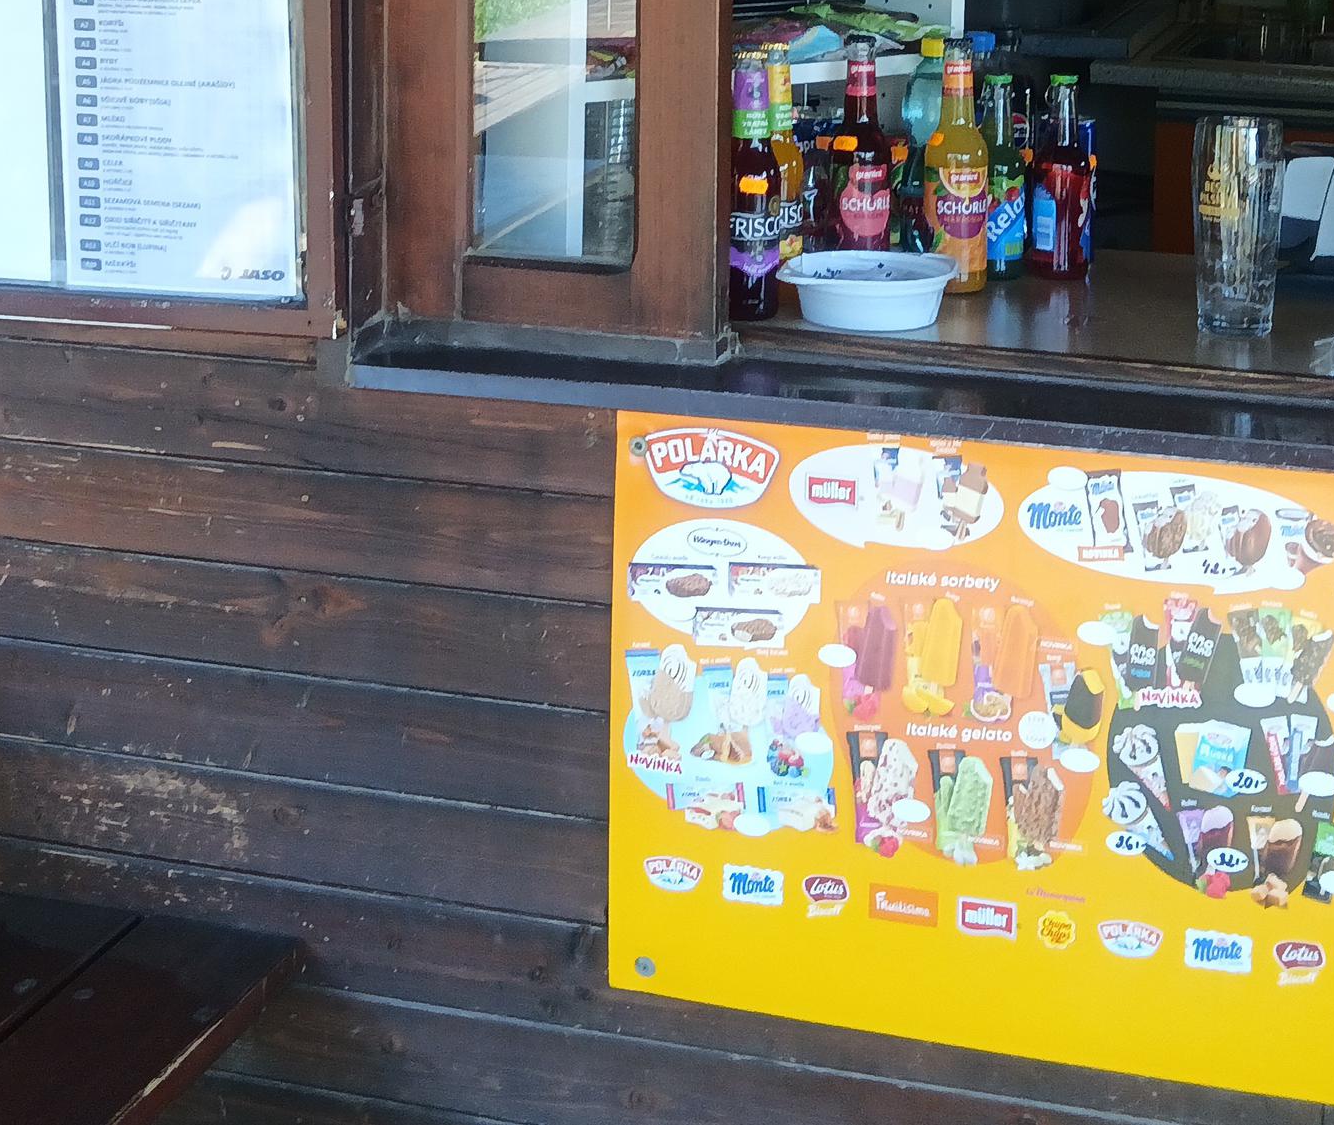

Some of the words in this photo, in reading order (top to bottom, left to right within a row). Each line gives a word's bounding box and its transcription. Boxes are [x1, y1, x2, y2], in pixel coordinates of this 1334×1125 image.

[810, 482, 853, 500] müller
[1028, 501, 1082, 529] Monte
[886, 570, 936, 587] Italské
[1142, 688, 1199, 705] NOVINKA
[906, 723, 957, 739] Italské
[961, 726, 1012, 743] gelato
[630, 753, 683, 775] NOVINKA
[730, 871, 775, 895] Monte
[1193, 936, 1244, 962] Monte
